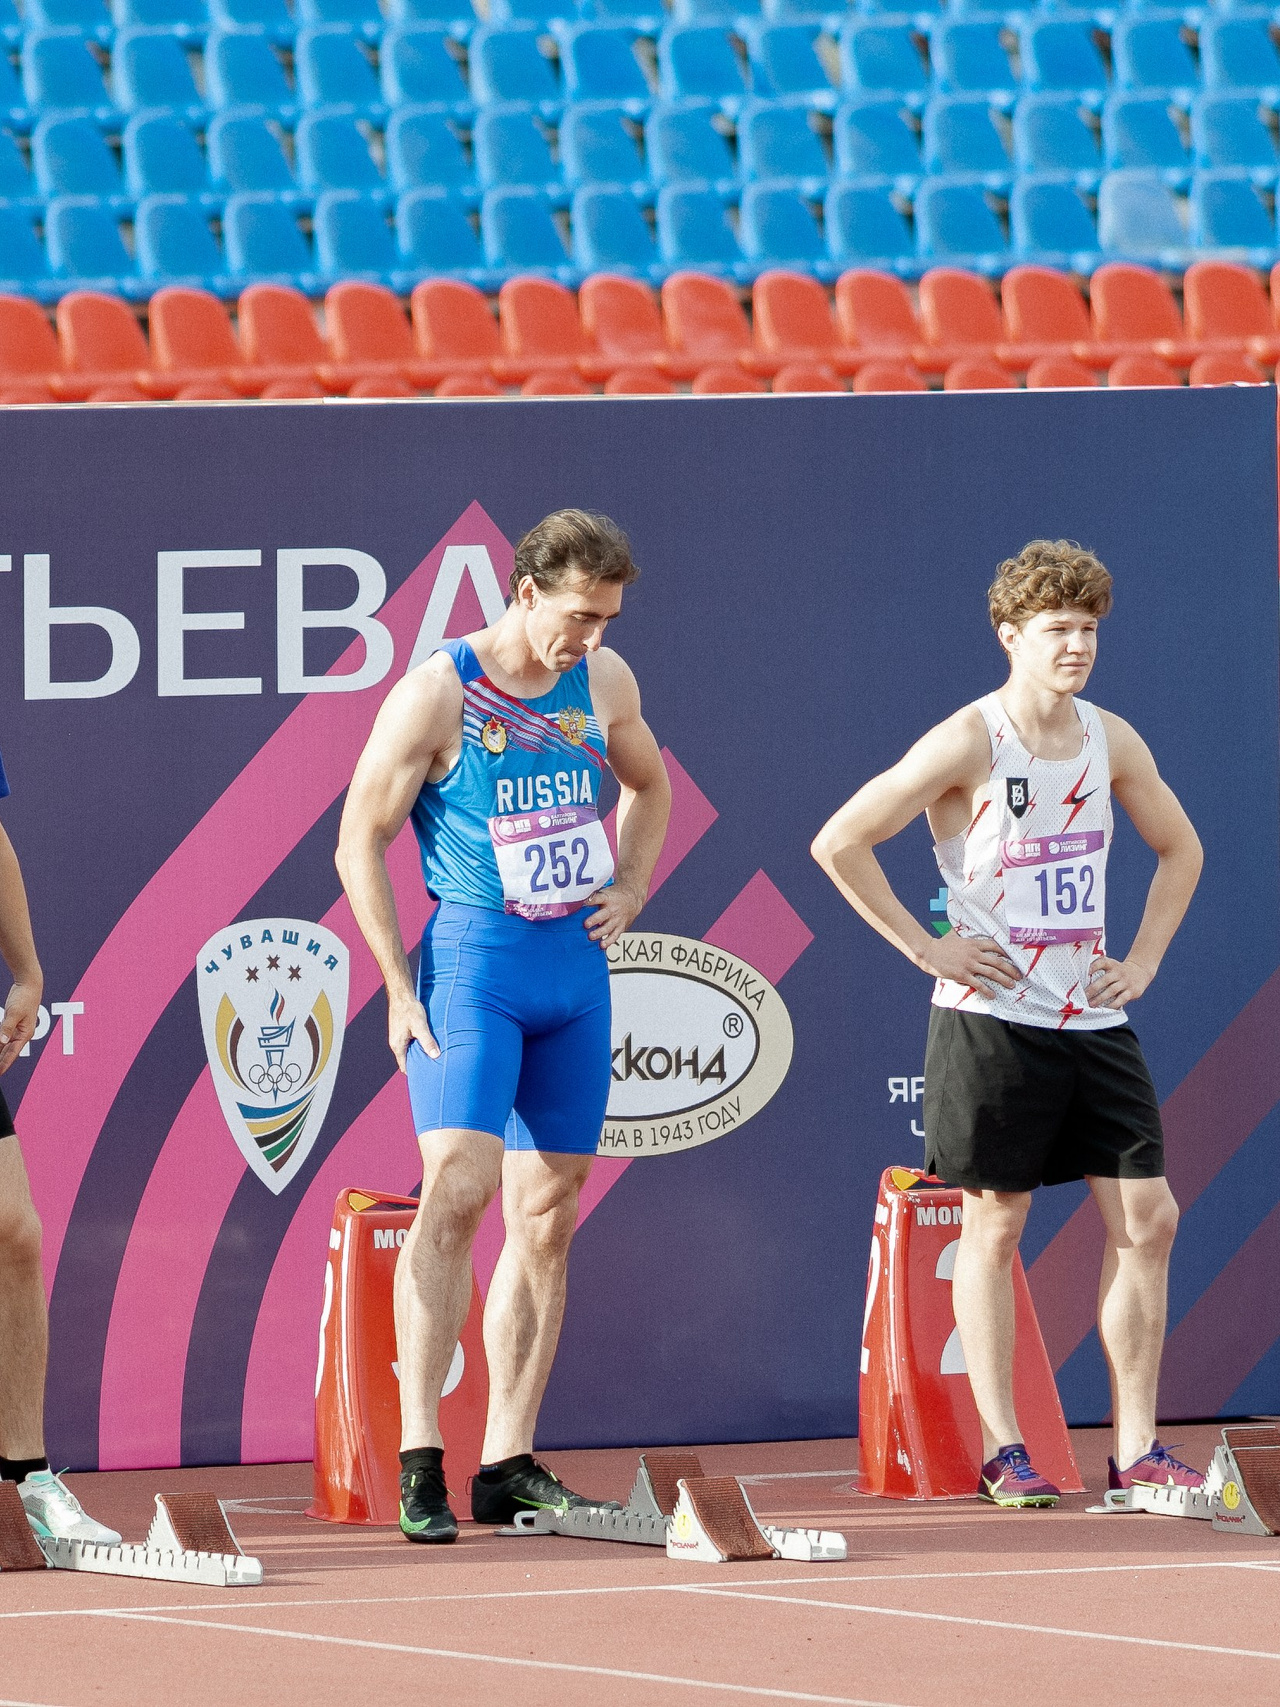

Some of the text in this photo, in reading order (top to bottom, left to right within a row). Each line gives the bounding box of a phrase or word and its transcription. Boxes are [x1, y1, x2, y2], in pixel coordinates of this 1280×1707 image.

[496, 769, 593, 813] RUSSIA
[524, 837, 594, 893] 252
[1034, 864, 1096, 917] 152
[205, 929, 339, 974] ЧУВАШИЯ
[671, 943, 766, 1012] ФАБРИКА
[600, 1095, 741, 1148] НА В 1943 ГОДУ
